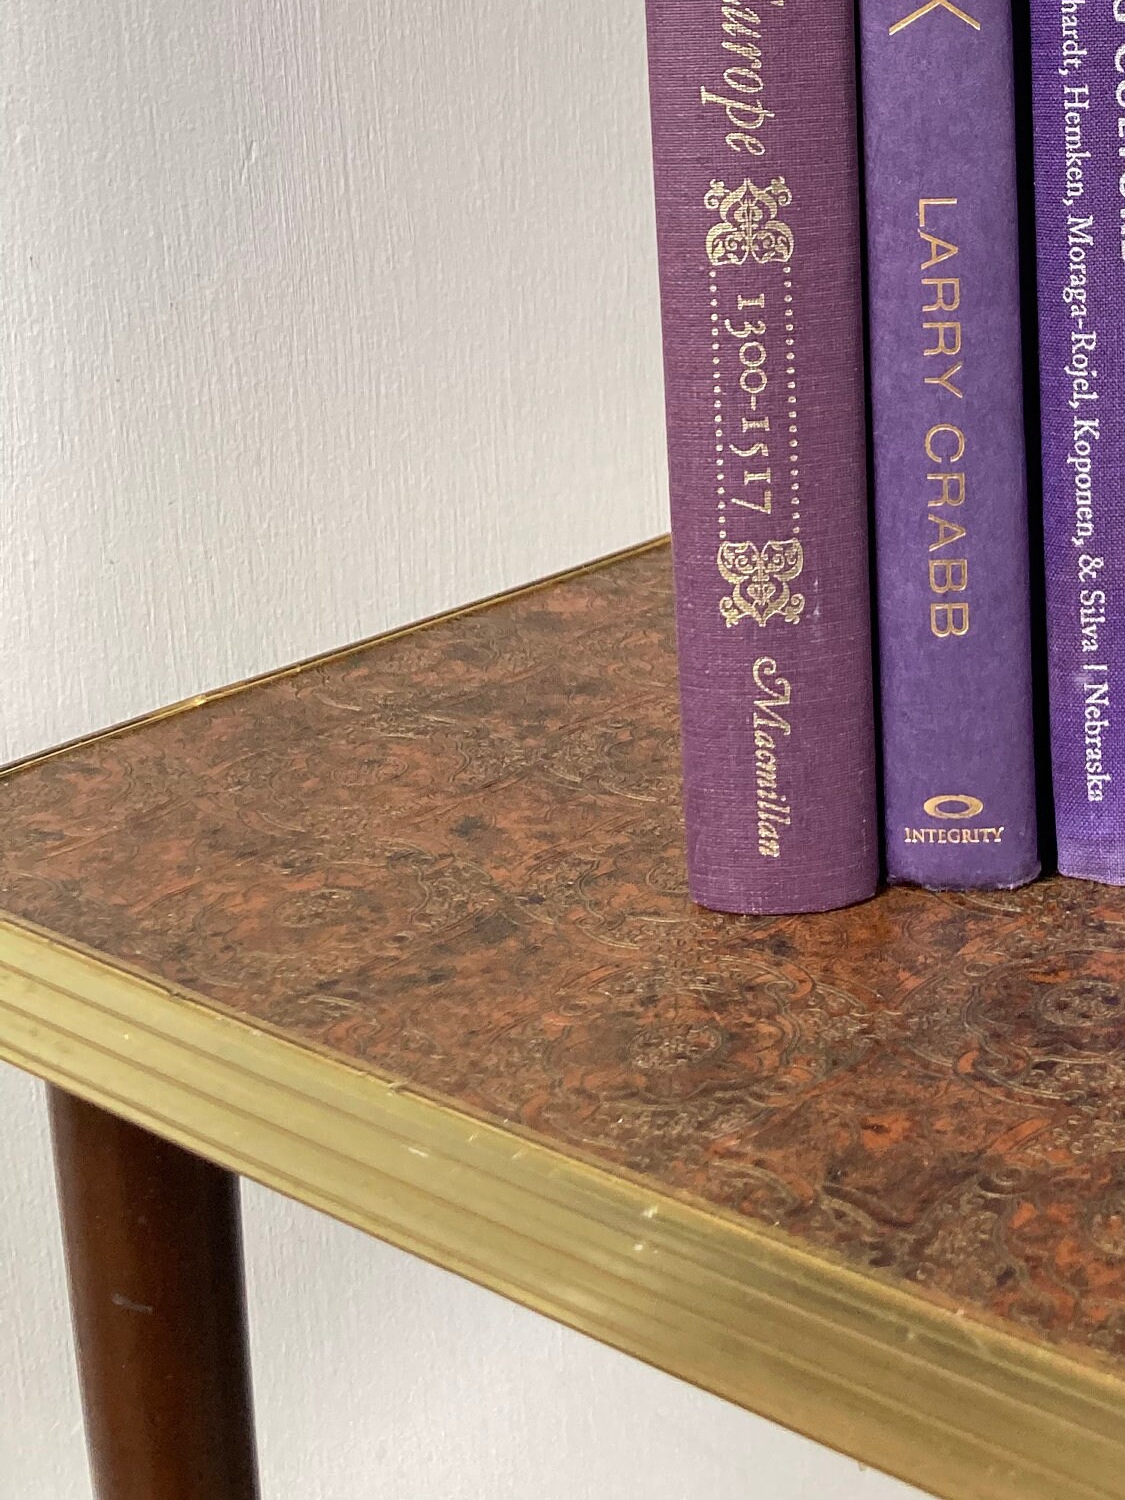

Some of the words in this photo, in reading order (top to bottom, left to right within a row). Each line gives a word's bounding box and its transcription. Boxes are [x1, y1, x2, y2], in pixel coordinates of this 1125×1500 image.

[1062, 84, 1092, 207] Hemken,
[917, 197, 963, 399] LARRY
[1062, 214, 1099, 410] Moraga-Rojel,
[924, 423, 970, 638] CRABB
[1066, 415, 1101, 547] Koponen,
[1077, 554, 1105, 583] &
[1079, 589, 1106, 653] Silva
[1083, 682, 1112, 802] Nebraska
[903, 825, 1005, 844] INTEGRITY
